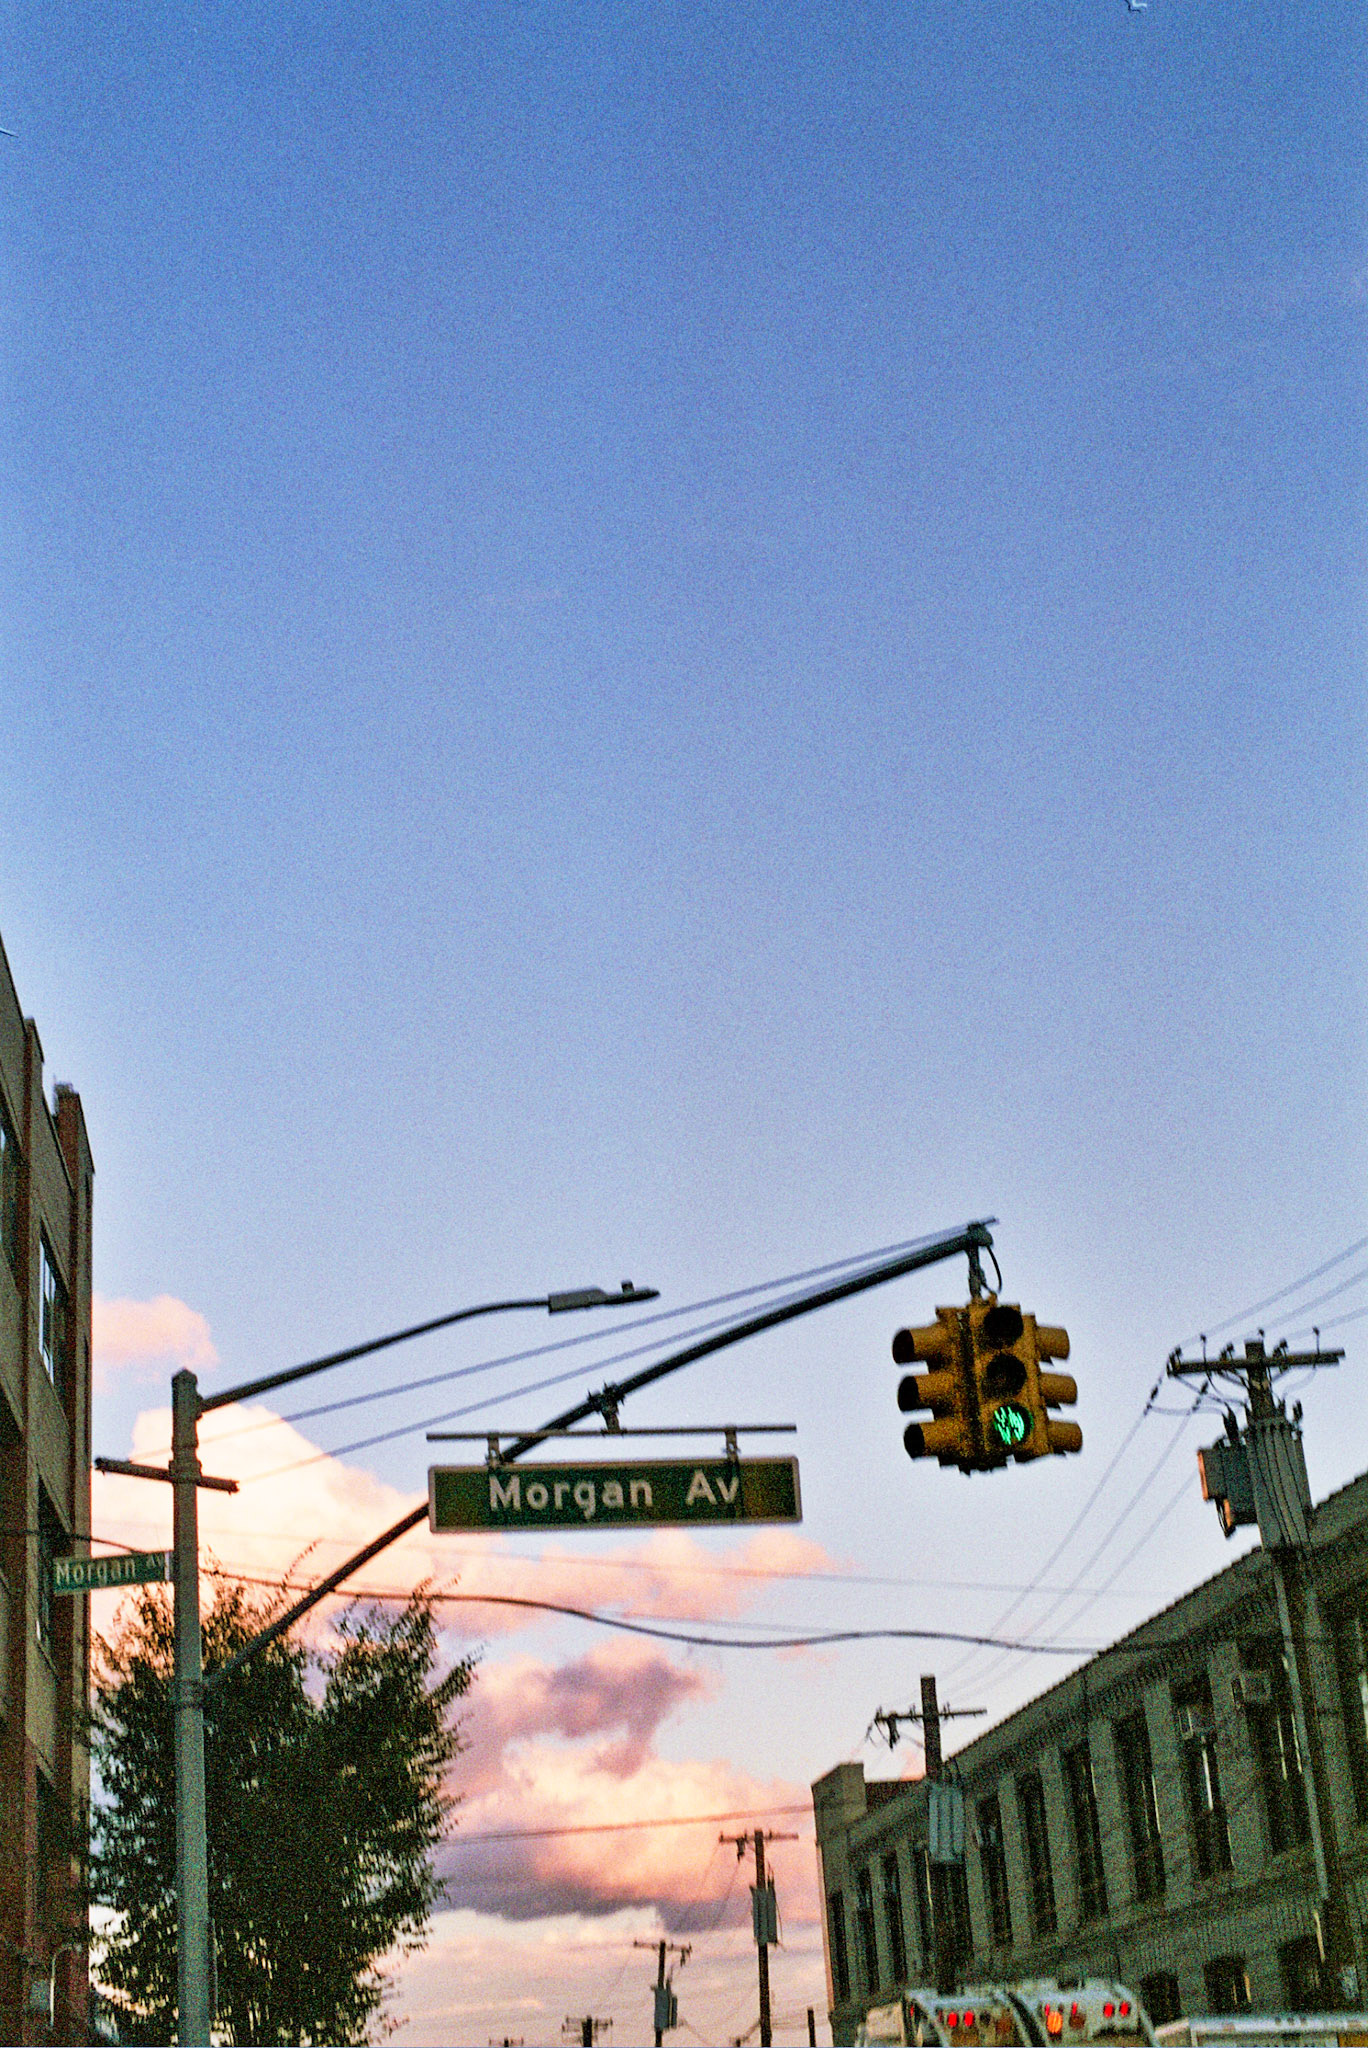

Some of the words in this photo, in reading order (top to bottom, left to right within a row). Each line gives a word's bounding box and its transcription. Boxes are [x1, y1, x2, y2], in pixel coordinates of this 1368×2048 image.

[489, 1474, 653, 1520] Morgan
[685, 1469, 740, 1506] Av
[56, 1559, 136, 1587] Morgan
